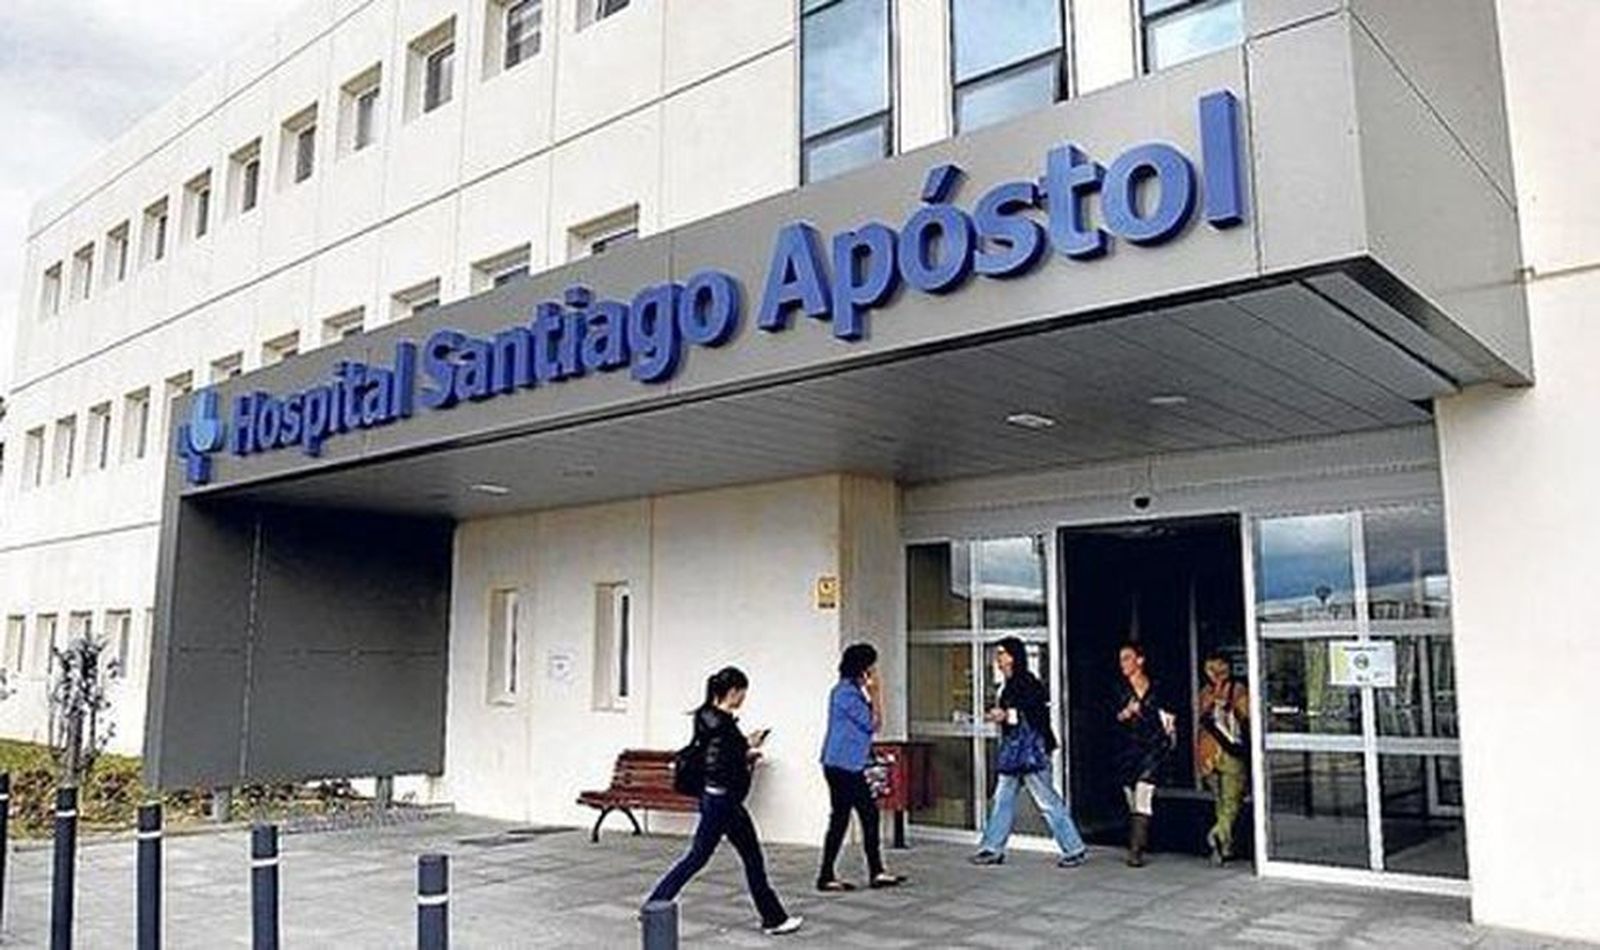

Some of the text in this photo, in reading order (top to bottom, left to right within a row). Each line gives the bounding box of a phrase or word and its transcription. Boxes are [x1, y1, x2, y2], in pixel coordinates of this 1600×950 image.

[232, 89, 1243, 456] Hospital Santiago Apóstol
